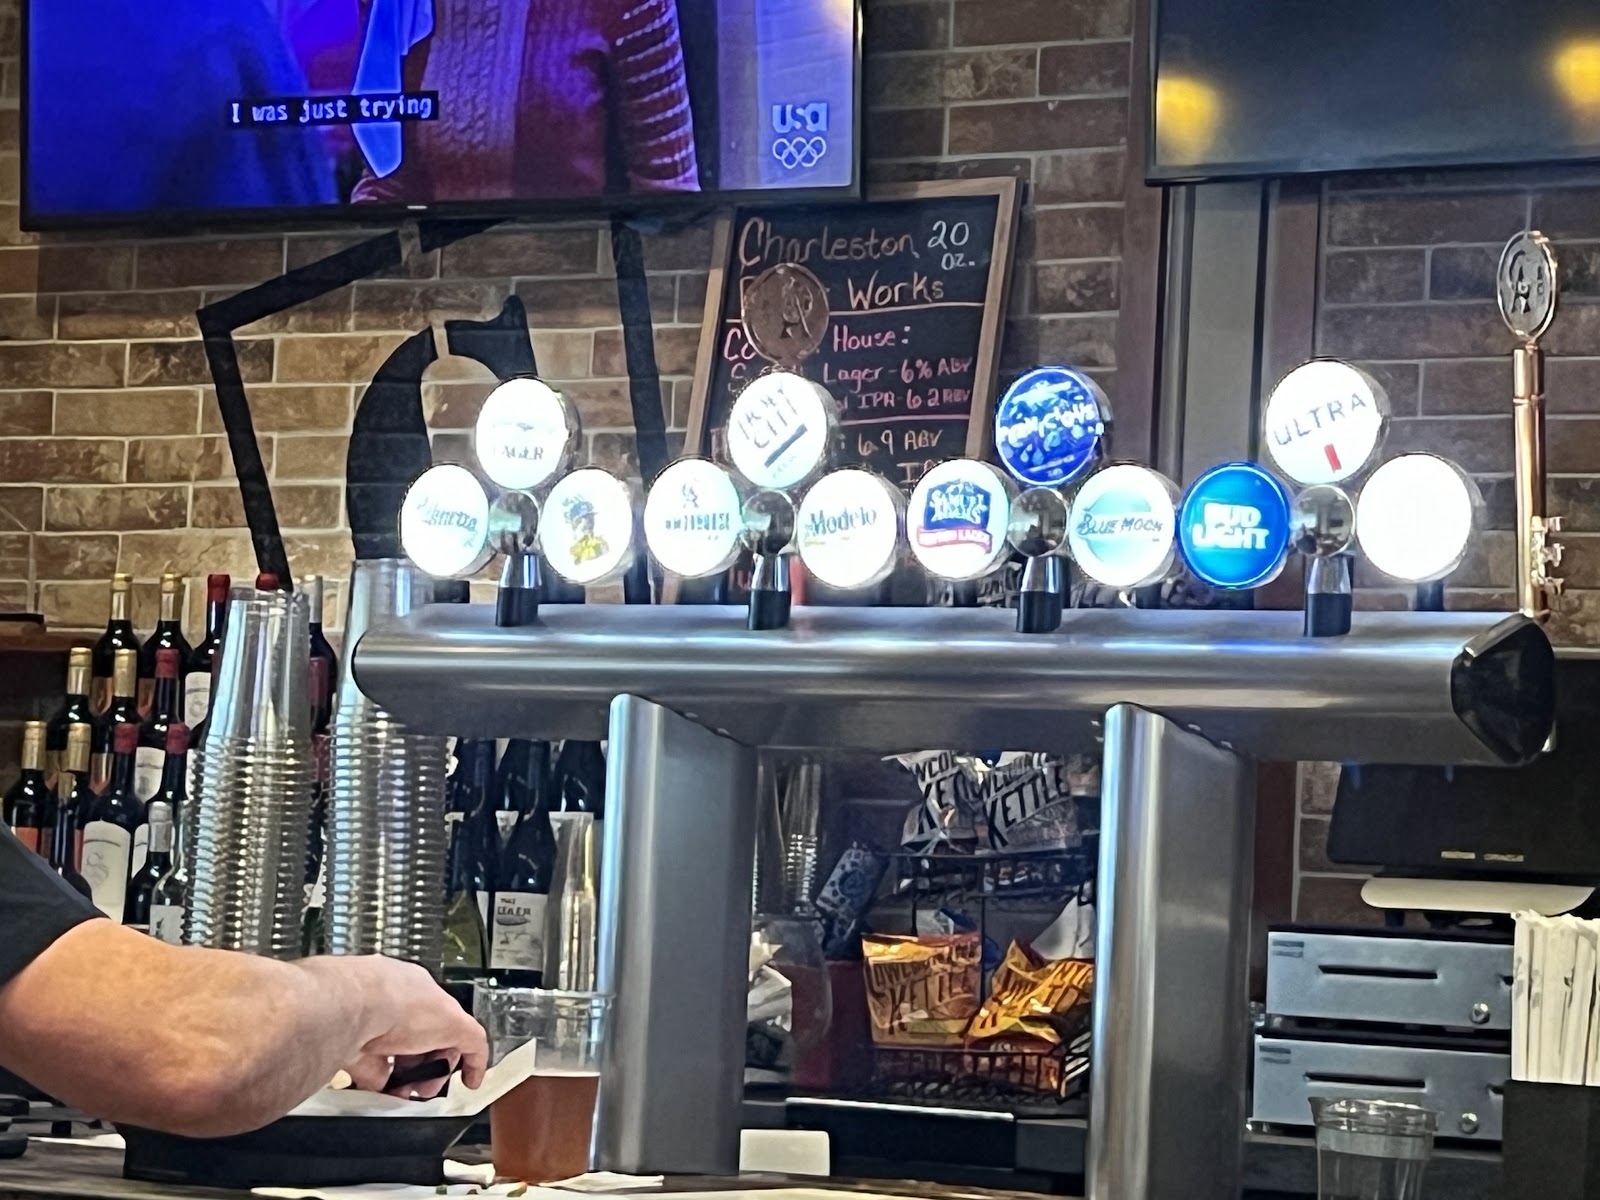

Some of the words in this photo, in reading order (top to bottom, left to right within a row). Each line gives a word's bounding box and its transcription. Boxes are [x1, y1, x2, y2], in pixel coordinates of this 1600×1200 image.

[231, 102, 240, 123] I
[251, 103, 289, 122] was
[299, 99, 348, 123] just
[359, 95, 433, 120] trying
[772, 102, 828, 133] usa
[738, 216, 920, 267] Charleston
[927, 220, 970, 250] 20
[847, 270, 944, 311] Works
[832, 324, 911, 352] House:
[822, 361, 884, 394] Lager
[900, 358, 933, 384] 6%
[937, 356, 973, 376] ABV
[857, 391, 896, 409] IPA
[1273, 392, 1367, 446] ULTRA
[904, 429, 943, 451] ABV
[809, 505, 877, 538] Modelo
[1203, 502, 1262, 528] BUD
